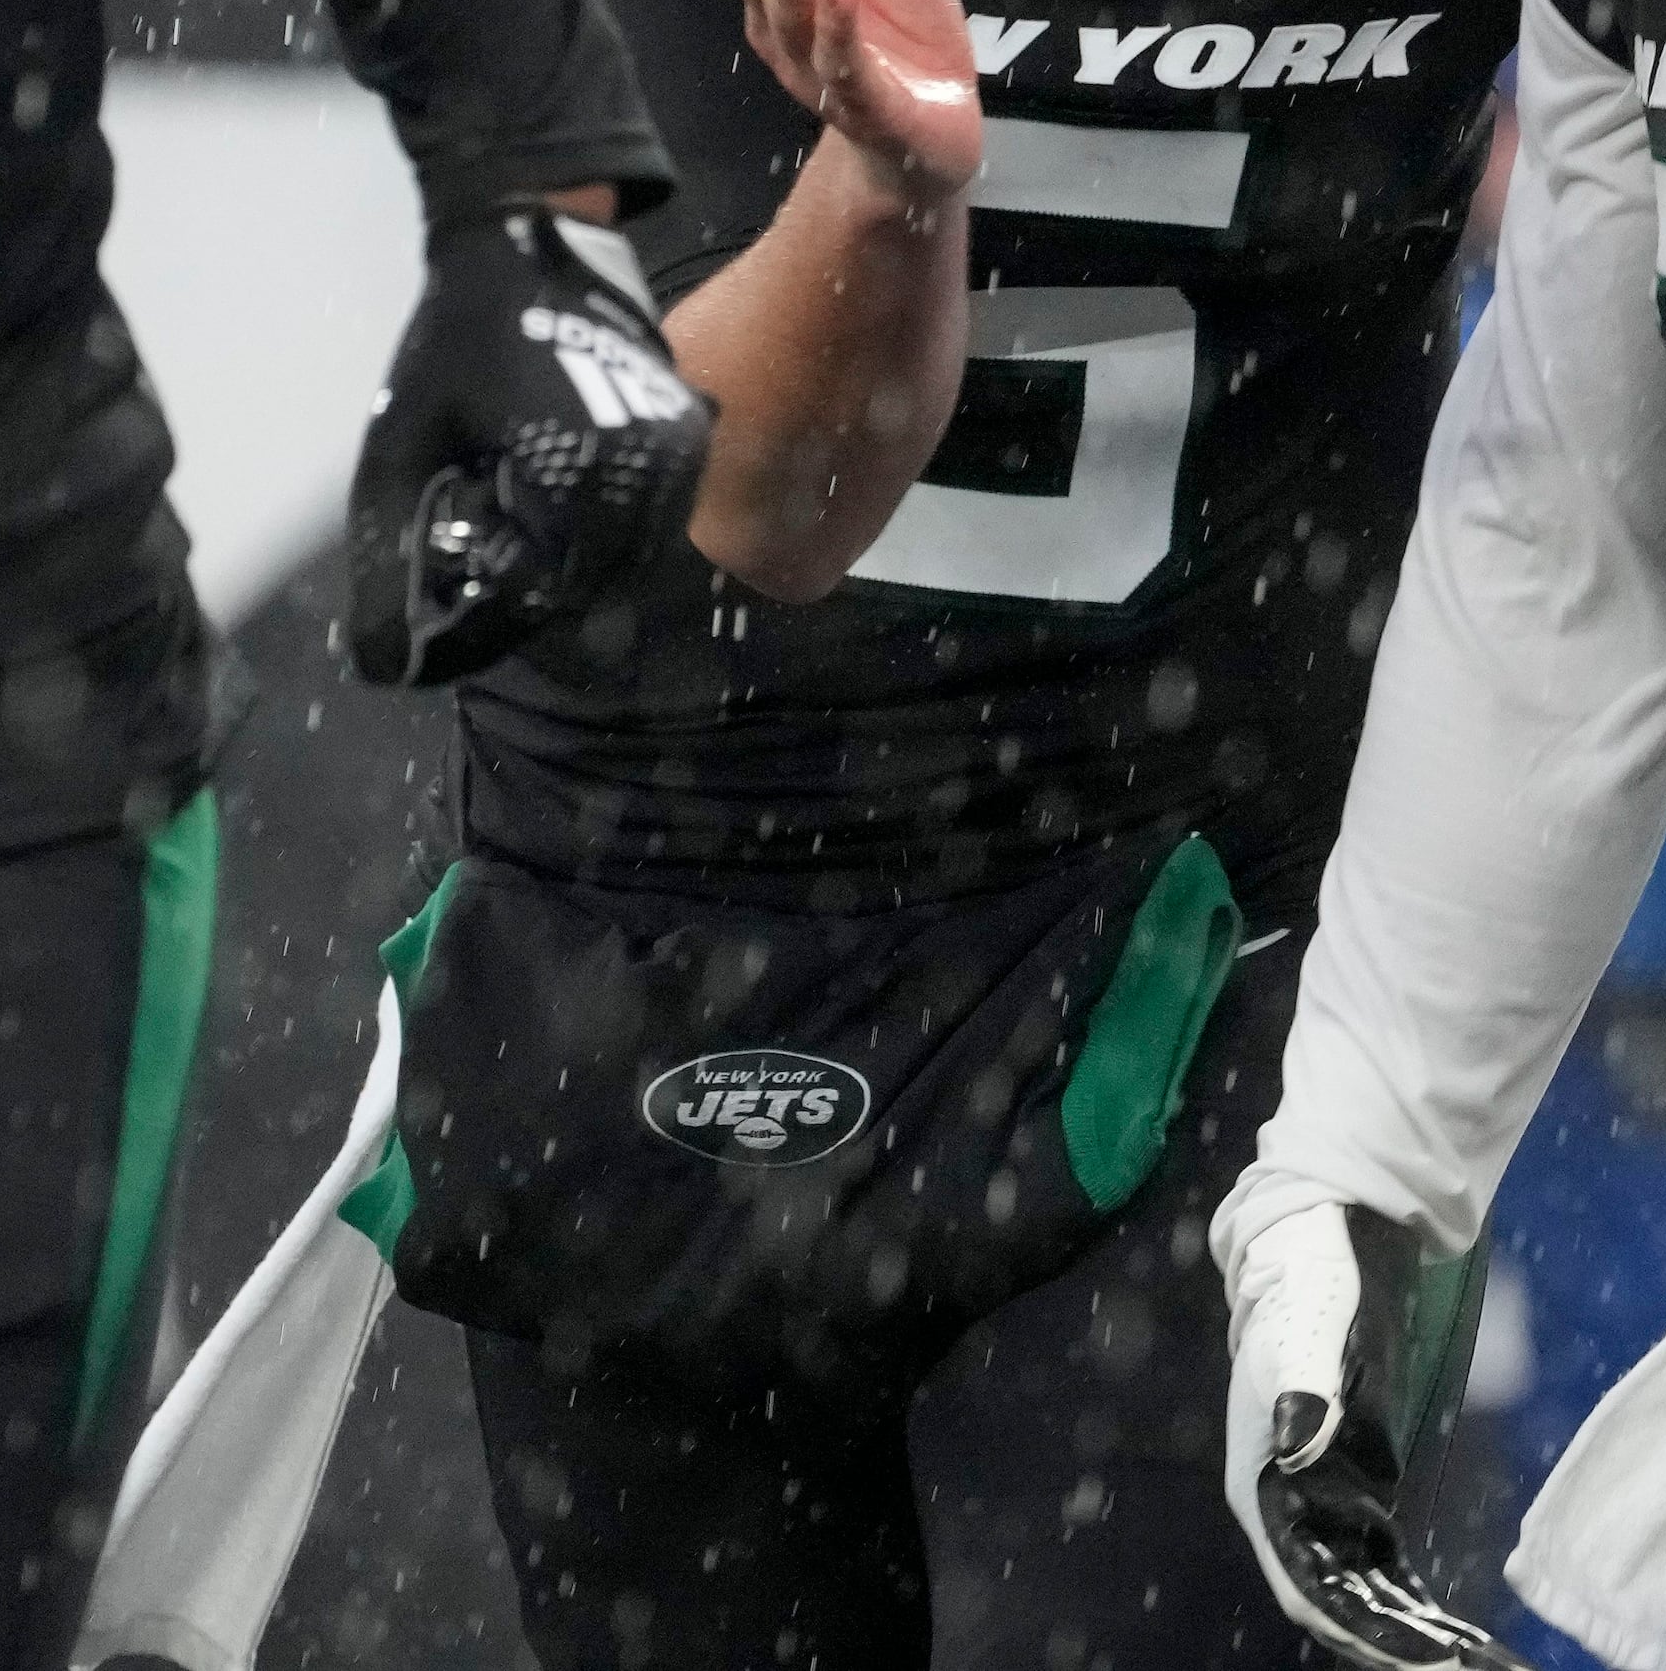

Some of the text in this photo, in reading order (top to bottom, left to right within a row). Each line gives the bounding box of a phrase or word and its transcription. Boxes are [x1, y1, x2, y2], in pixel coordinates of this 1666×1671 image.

[1072, 11, 1444, 90] YORK
[844, 115, 1251, 605] 5
[694, 1069, 828, 1085] NEW YORK
[676, 1087, 840, 1127] JETS
